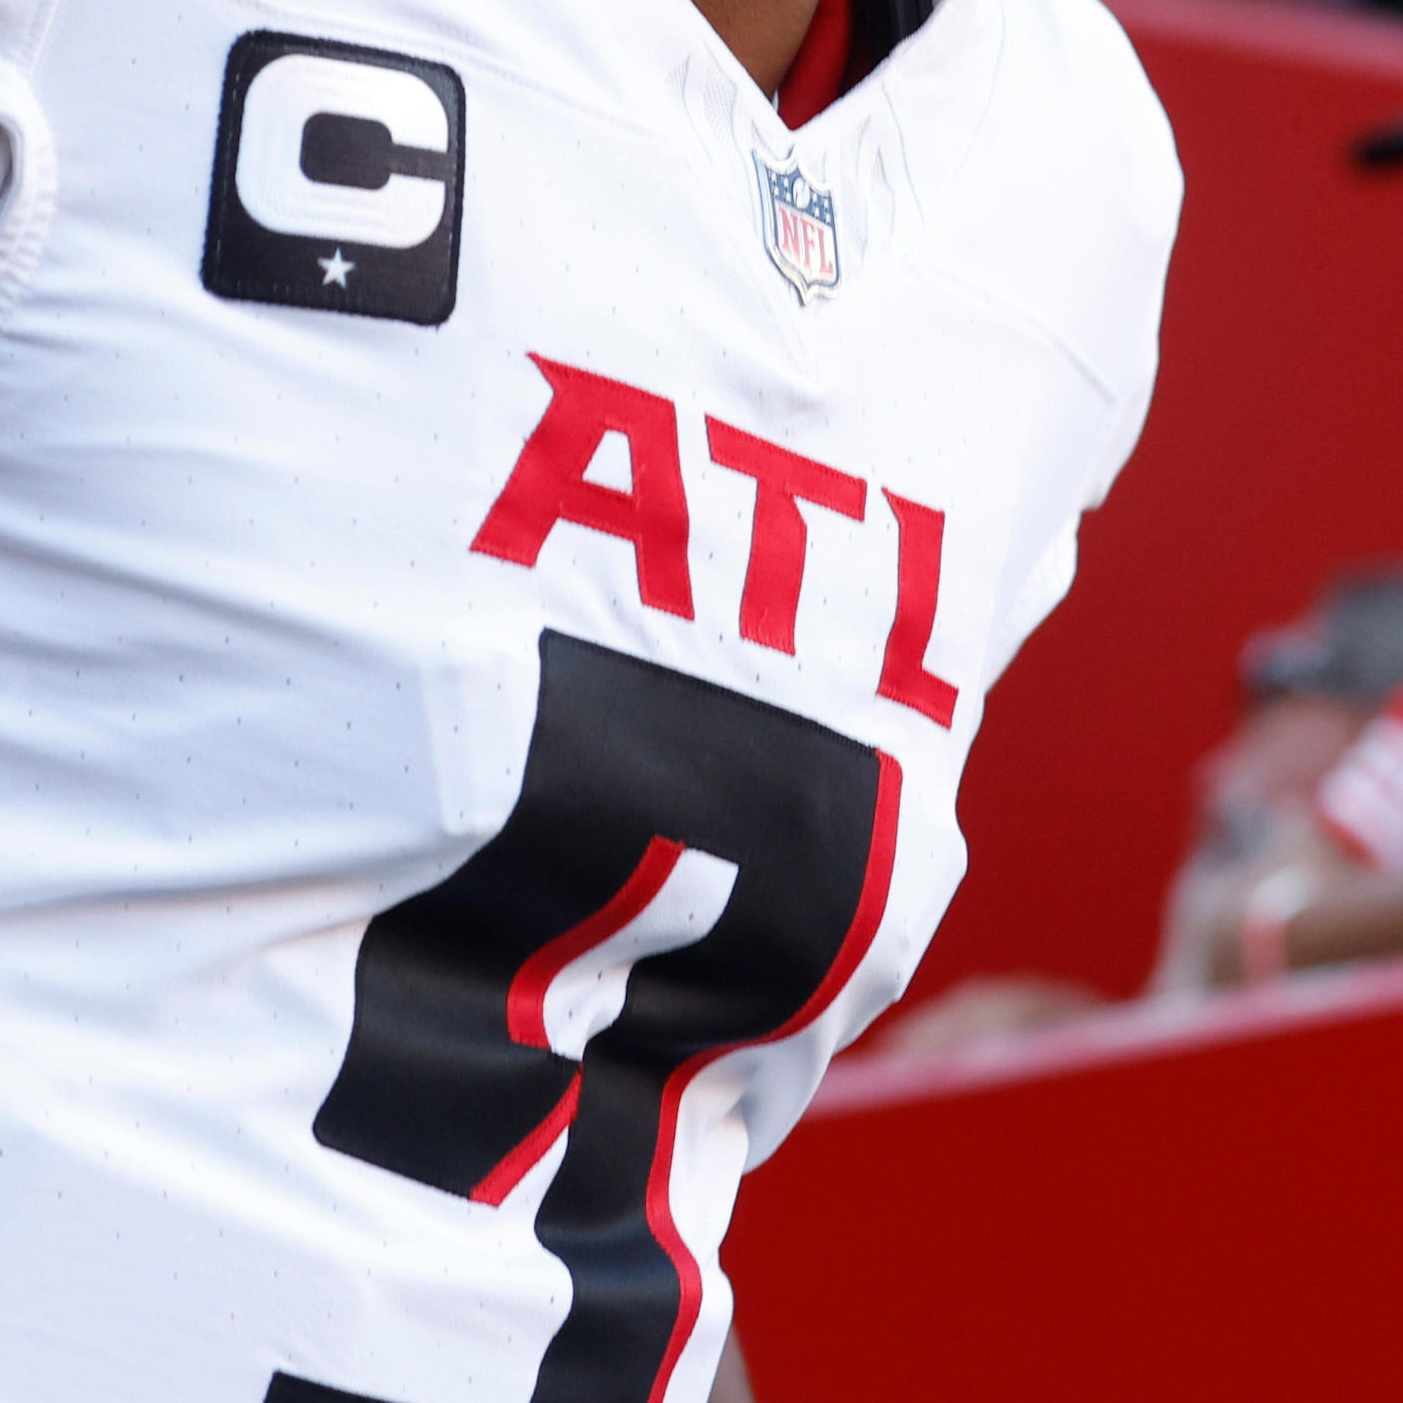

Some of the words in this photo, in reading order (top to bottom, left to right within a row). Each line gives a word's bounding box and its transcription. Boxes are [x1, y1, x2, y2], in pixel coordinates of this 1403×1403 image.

[236, 53, 450, 249] C
[780, 207, 834, 274] NFL
[469, 351, 958, 730] ATL
